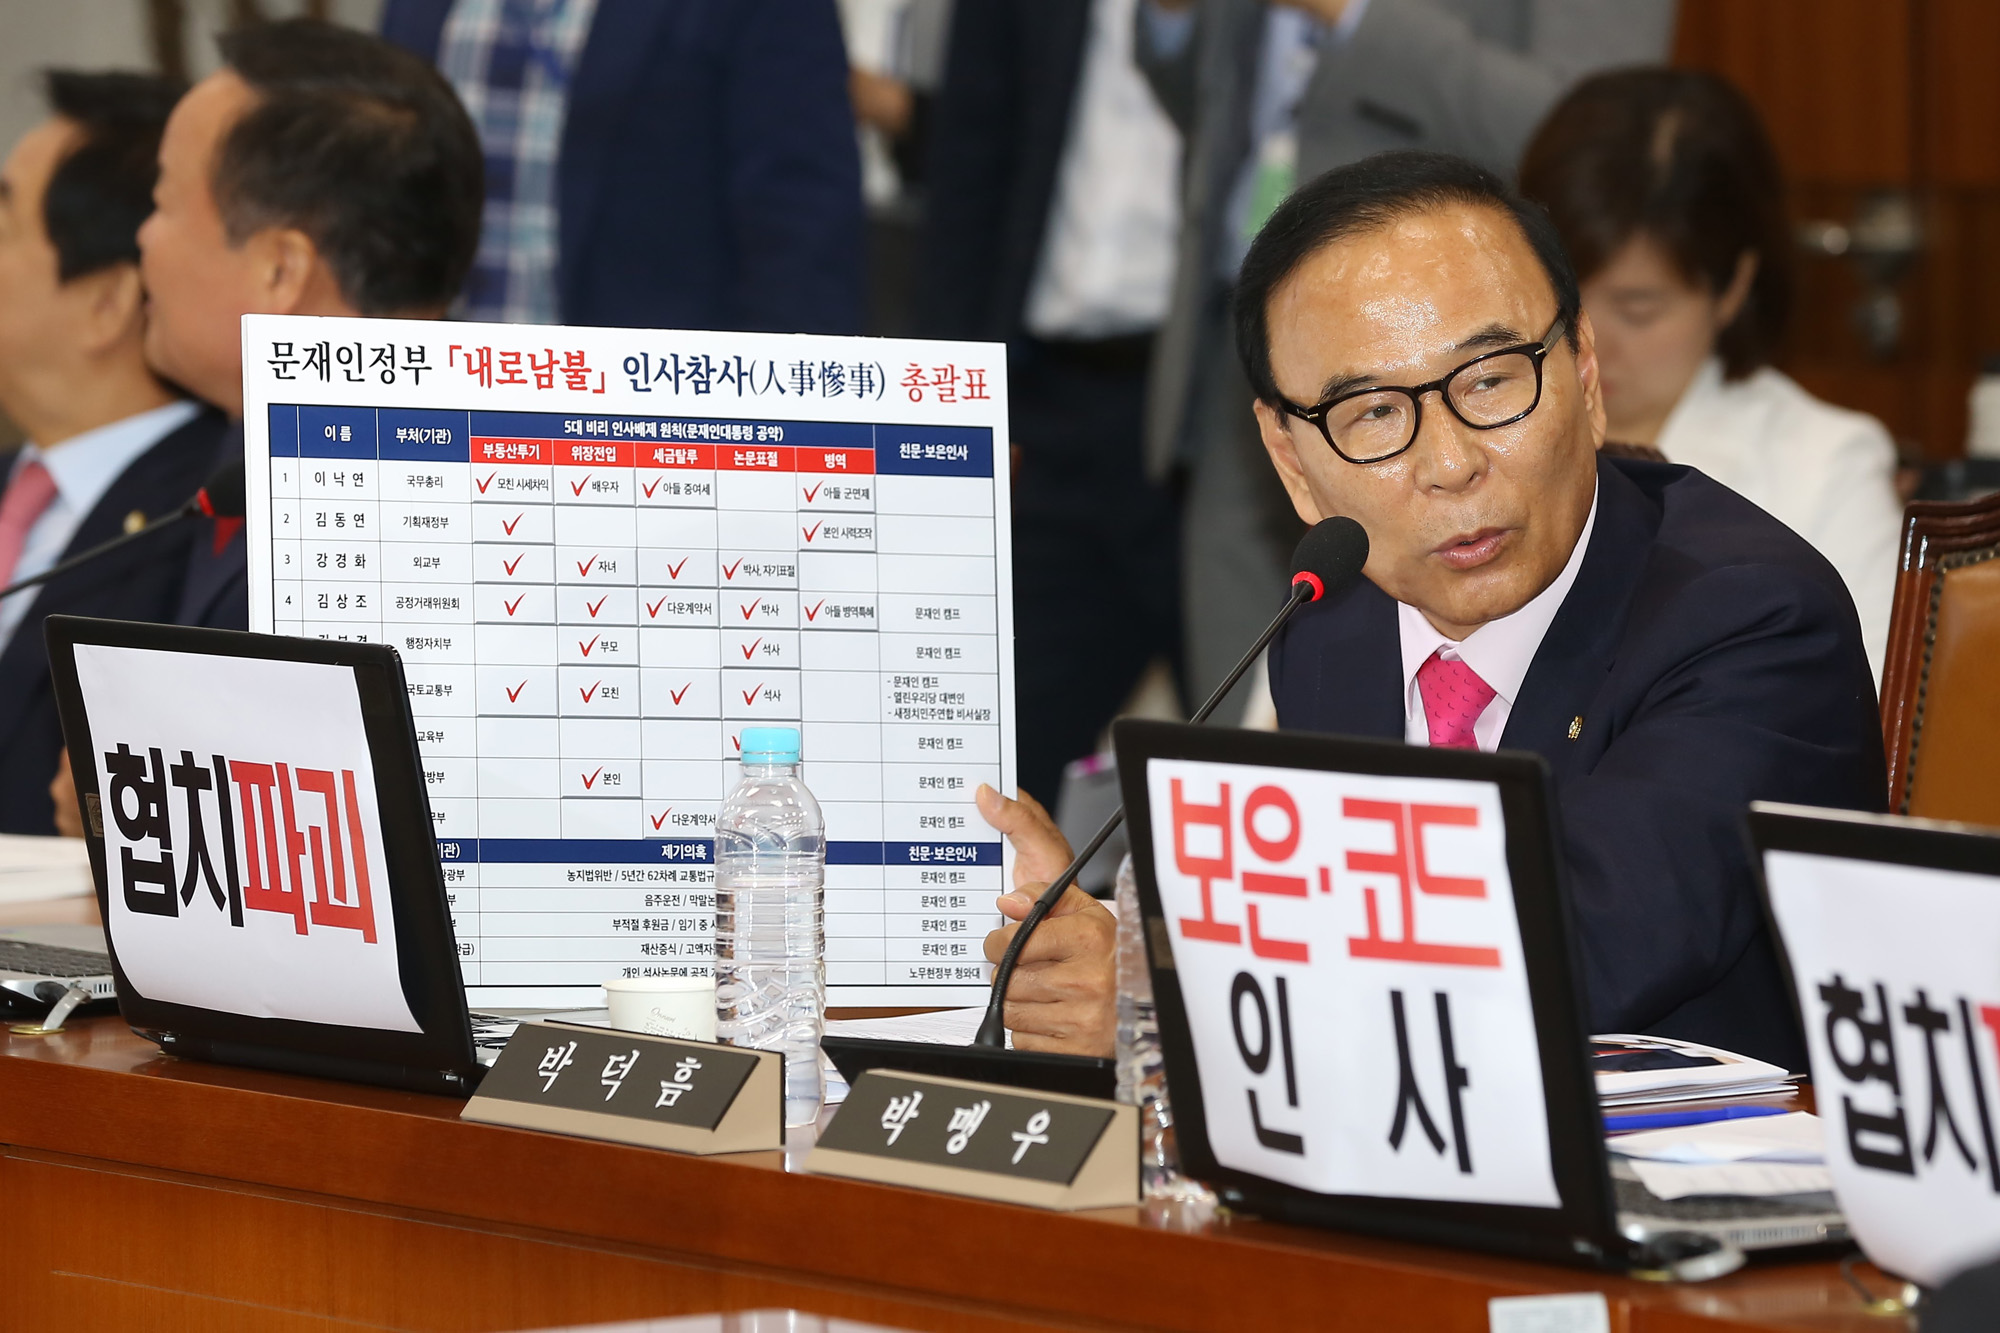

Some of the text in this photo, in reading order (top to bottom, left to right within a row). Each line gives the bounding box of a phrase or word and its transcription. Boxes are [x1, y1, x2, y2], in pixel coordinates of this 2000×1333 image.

[267, 340, 433, 386] 문재인정부
[900, 362, 991, 403] 총괄표
[395, 427, 452, 445] 부처(기관)
[564, 419, 784, 442] 5대 비리 인사배제 원칙(문재인대통령 공약)
[482, 442, 540, 460] 부동산투기
[571, 445, 617, 463] 위장전입
[652, 447, 699, 465] 세금탈루
[733, 450, 778, 468] 논문표절
[824, 452, 847, 470] 병역
[283, 472, 287, 483] 1
[406, 475, 443, 489] 국무총리
[497, 477, 549, 492] 모친 시세차익
[591, 480, 620, 493] 배우자
[662, 482, 711, 496] 아들 증여세
[823, 486, 870, 500] 아들 군면제
[283, 513, 290, 524] 2
[403, 515, 449, 529] 기획재정부
[823, 526, 873, 540] 본인 시력조작
[284, 553, 291, 565] 3
[413, 556, 441, 569] 외교부
[598, 560, 617, 573] 자녀
[762, 564, 795, 578] 자기표절
[285, 595, 292, 605] 4
[395, 596, 460, 610] 공정거래위원회
[667, 601, 712, 615] 다운계약서
[761, 604, 780, 617] 박사
[824, 605, 875, 619] 아들 병역특혜
[915, 607, 961, 621] 문재인 캠프
[405, 637, 452, 650] 행정자치부
[600, 641, 619, 653] 부모
[762, 643, 781, 656] 석사
[916, 646, 961, 660] 문재인 캠프
[893, 675, 919, 689] 문재인
[922, 676, 939, 689] 캠프
[408, 682, 453, 698] 국토교통부
[601, 686, 619, 700] 모친
[763, 689, 782, 702] 석사
[893, 691, 937, 705] 열린우리당
[939, 692, 965, 705] 대변인
[894, 707, 955, 721] 새정치민주연합
[956, 708, 991, 721] 비서실장
[418, 730, 444, 743] 교육부
[917, 737, 964, 750] 문재인 캠프
[423, 771, 446, 784] 방부
[603, 772, 621, 786] 본인
[919, 776, 964, 790] 문재인 캠프
[671, 813, 716, 826] 다운계약서
[919, 815, 965, 829] 문재인 캠프
[104, 743, 377, 944] 협치파괴
[661, 843, 707, 860] 제기의혹
[567, 869, 613, 882] 농지법위반
[621, 869, 645, 882] 5년간
[647, 869, 677, 882] 62차례
[679, 869, 714, 882] 교통법규
[920, 871, 966, 884] 문재인 캠프
[644, 894, 681, 907] 음주운전
[921, 895, 967, 908] 문재인 캠프
[612, 918, 640, 932] 부적절
[642, 918, 670, 932] 후원금
[678, 918, 696, 932] 임기
[698, 918, 708, 932] 중
[921, 919, 967, 932] 문재인 캠프
[640, 942, 677, 956] 재산증식
[686, 944, 716, 956] 고액자
[921, 943, 968, 956] 문재인 캠프
[622, 968, 640, 978] 개인
[643, 967, 688, 977] 석사논문에
[909, 967, 981, 980] 노무현정부 청와대
